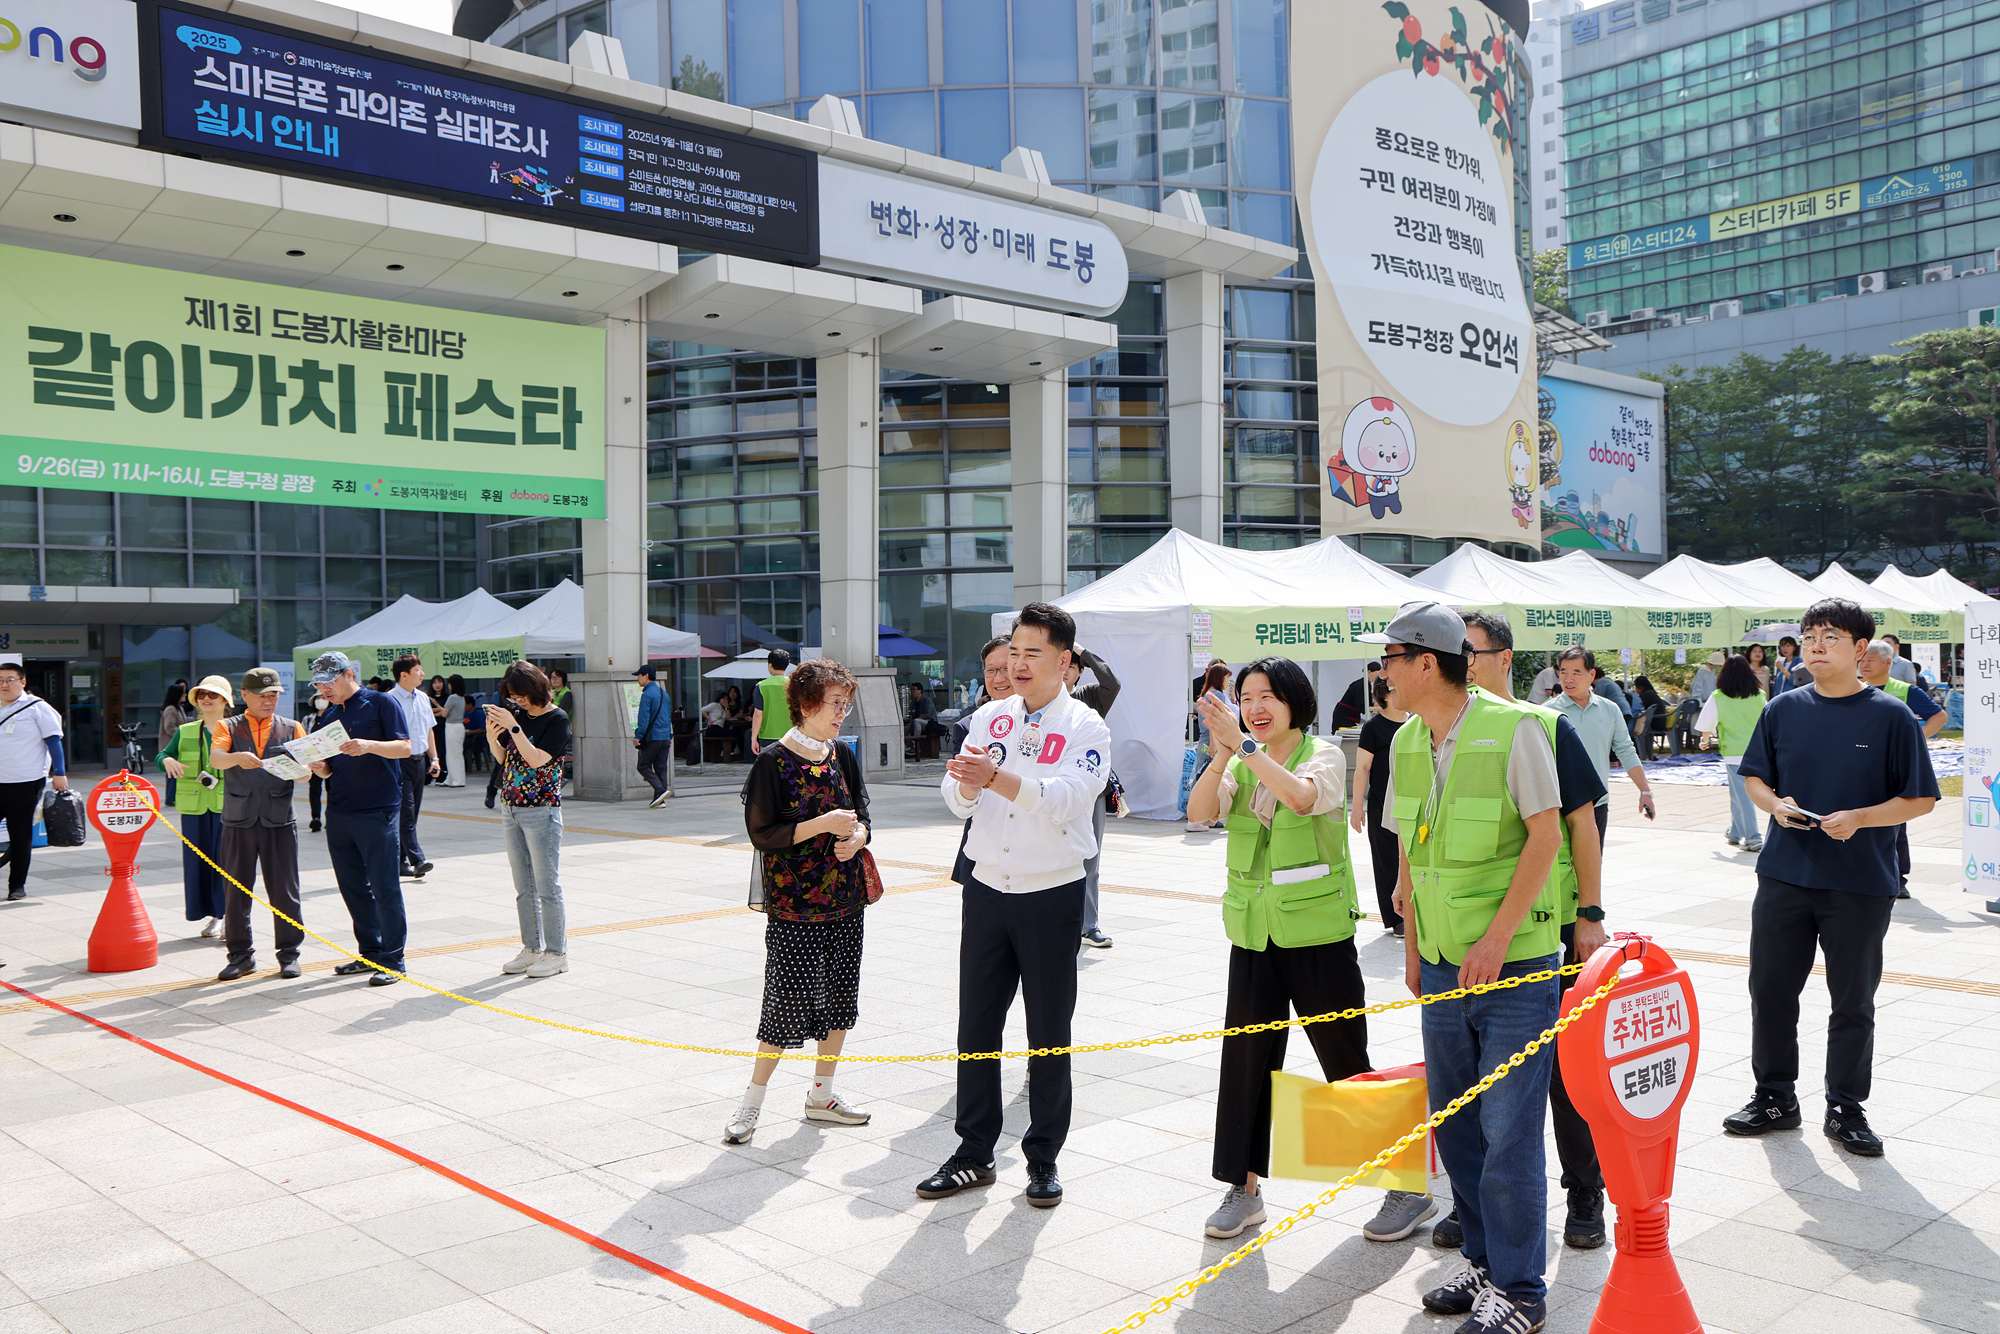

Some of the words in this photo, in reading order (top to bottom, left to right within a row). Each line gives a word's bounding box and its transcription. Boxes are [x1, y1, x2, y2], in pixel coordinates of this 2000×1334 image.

[191, 31, 227, 49] 2025
[424, 84, 442, 98] NIA
[194, 56, 328, 114] 스마트폰
[335, 85, 427, 134] 과의존
[434, 107, 549, 158] 실태조사
[194, 100, 263, 143] 실시
[271, 115, 339, 157] 안내
[584, 119, 618, 135] 조사기간
[627, 129, 660, 145] 2025년
[584, 139, 619, 156] 조사대상
[1375, 126, 1440, 164] 풍요로운
[1444, 146, 1485, 184] 한가위,
[585, 160, 619, 177] 조사내용
[660, 155, 676, 168] 가구
[1932, 163, 1951, 174] 010
[1938, 170, 1963, 182] 3300
[1944, 179, 1968, 191] 3153
[1359, 167, 1396, 194] 구민
[1401, 175, 1461, 211] 여러분의
[1465, 195, 1497, 226] 가정에
[1718, 195, 1817, 234] 스터디카페
[1825, 189, 1852, 211] 5F
[1393, 215, 1443, 245] 건강과
[1446, 226, 1485, 258] 행복이
[1046, 237, 1096, 285] 도봉
[1371, 253, 1456, 287] 가득하시길
[1457, 270, 1506, 302] 바랍니다
[184, 295, 262, 338] 제1회
[271, 307, 466, 360] 도봉자활한마당
[1368, 320, 1454, 355] 도봉구청장
[1459, 321, 1519, 374] 오언석
[27, 325, 358, 435] 같이가치
[384, 370, 583, 451] 페스타
[1619, 405, 1635, 423] 같이
[1635, 417, 1654, 439] 변화,
[1589, 439, 1635, 473] dobong
[1611, 425, 1636, 449] 행복한
[1637, 440, 1651, 462] 도봉
[17, 454, 106, 479] 9/26(금)
[112, 461, 205, 488] 11시~16시,
[208, 468, 279, 491] 도봉구청
[281, 473, 316, 493] 광장
[331, 479, 357, 494] 주최
[390, 486, 467, 501] 도봉지역자활센터
[481, 488, 503, 502] 후원
[510, 488, 550, 503] dobong
[553, 494, 588, 507] 도봉구청
[1255, 621, 1311, 645] 우리동네
[1315, 622, 1345, 644] 한식,
[1037, 733, 1067, 765] D
[1969, 747, 1992, 757] 다회용기
[107, 815, 143, 826] 도봉자활
[1620, 1000, 1634, 1014] 협조
[1635, 989, 1670, 1009] 부탁드립니다
[1613, 999, 1682, 1049] 주차금지
[1624, 1057, 1677, 1100] 도봉자활
